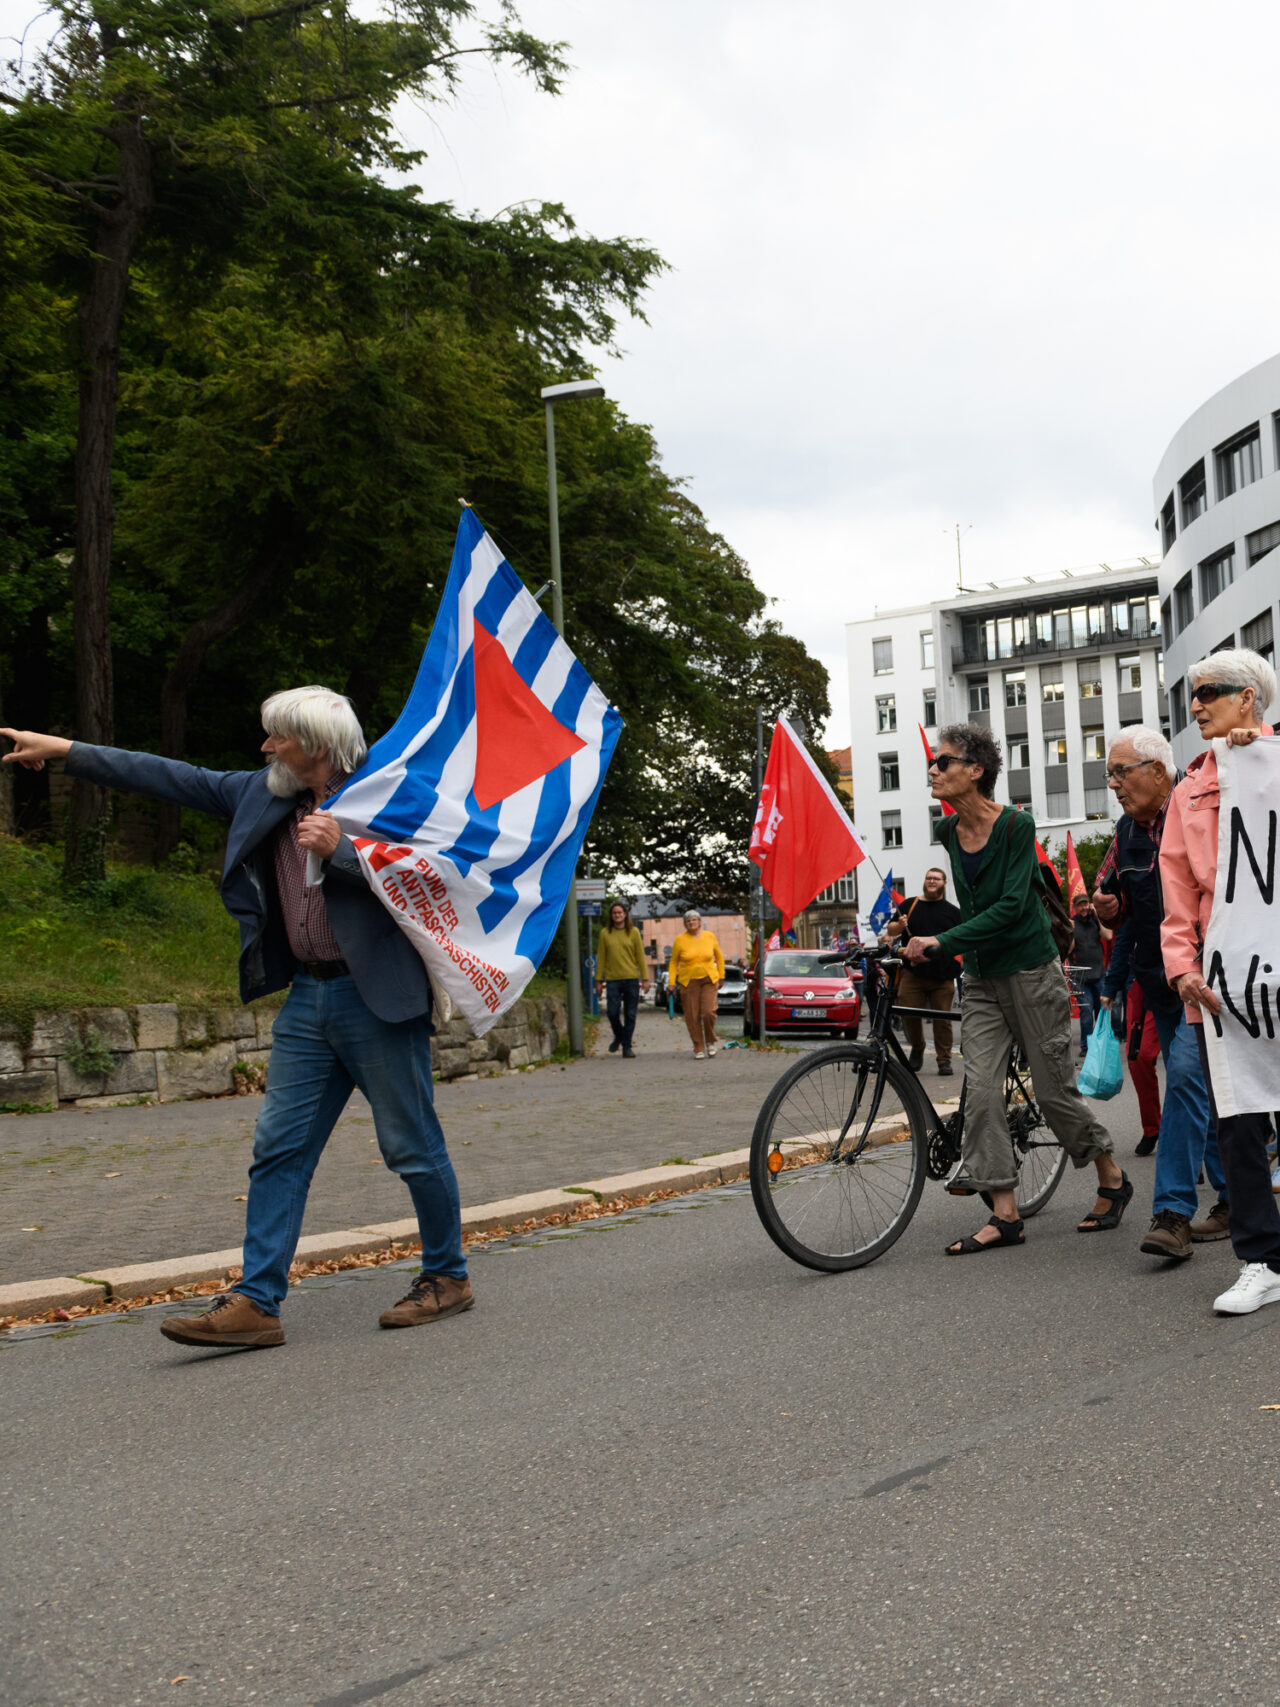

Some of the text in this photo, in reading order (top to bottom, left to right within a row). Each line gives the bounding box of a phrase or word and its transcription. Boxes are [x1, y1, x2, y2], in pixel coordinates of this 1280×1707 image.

[382, 876, 408, 912] UND
[396, 868, 510, 993] ANTIFASCHTINNEN
[414, 857, 459, 932] BUND DER
